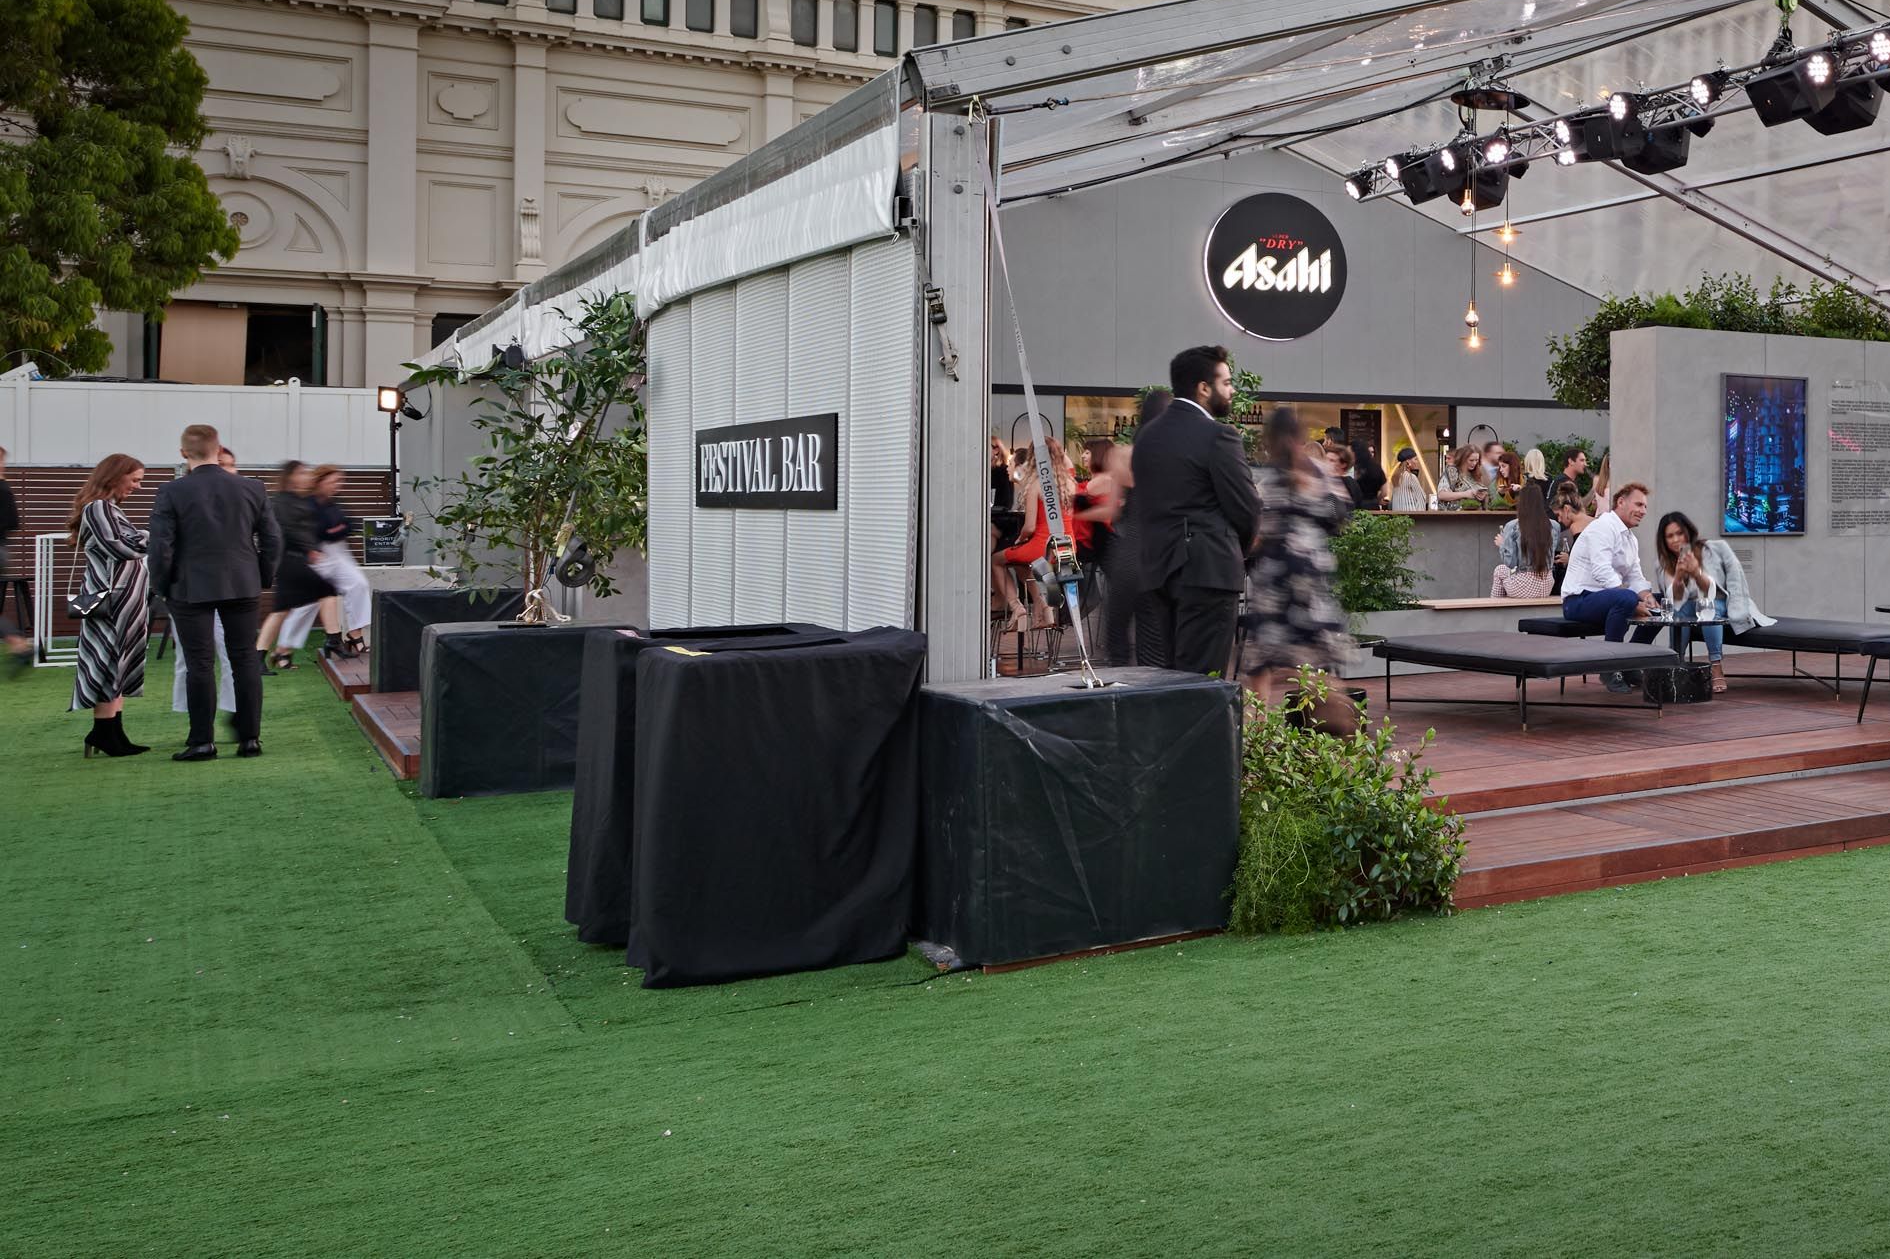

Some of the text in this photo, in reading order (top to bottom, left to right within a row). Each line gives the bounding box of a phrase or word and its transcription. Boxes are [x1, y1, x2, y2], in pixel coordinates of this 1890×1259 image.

[1222, 243, 1332, 294] Asahi
[699, 433, 823, 494] FESTIVAL BAR
[1038, 460, 1058, 521] LC:1500KG
